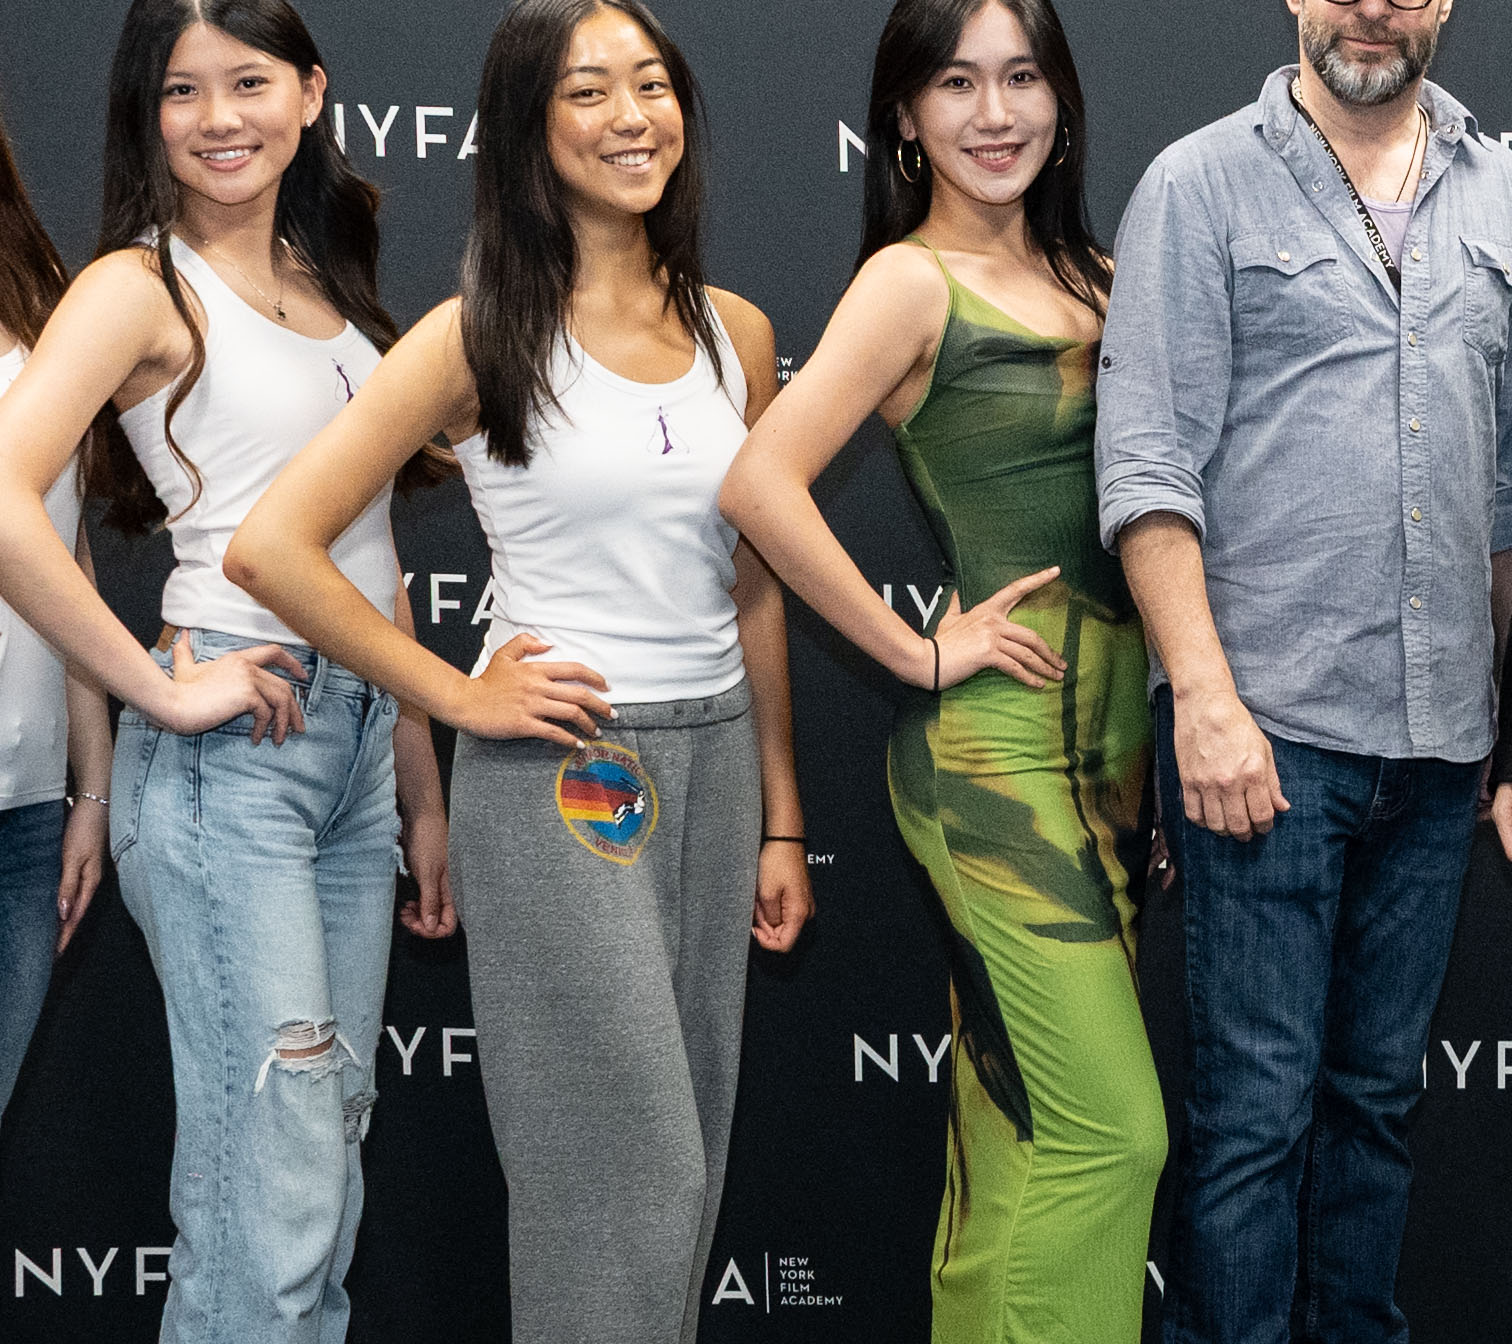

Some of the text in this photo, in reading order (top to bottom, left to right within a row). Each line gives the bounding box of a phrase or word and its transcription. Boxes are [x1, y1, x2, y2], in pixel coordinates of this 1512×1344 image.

[1359, 213, 1395, 269] ACADEMY
[385, 1025, 477, 1077] YF
[853, 1032, 953, 1083] NY
[14, 1246, 174, 1298] NYF
[779, 1256, 809, 1267] NEW
[779, 1269, 815, 1280] YORK
[779, 1282, 810, 1293] FILM
[780, 1295, 843, 1306] ACADEMY
